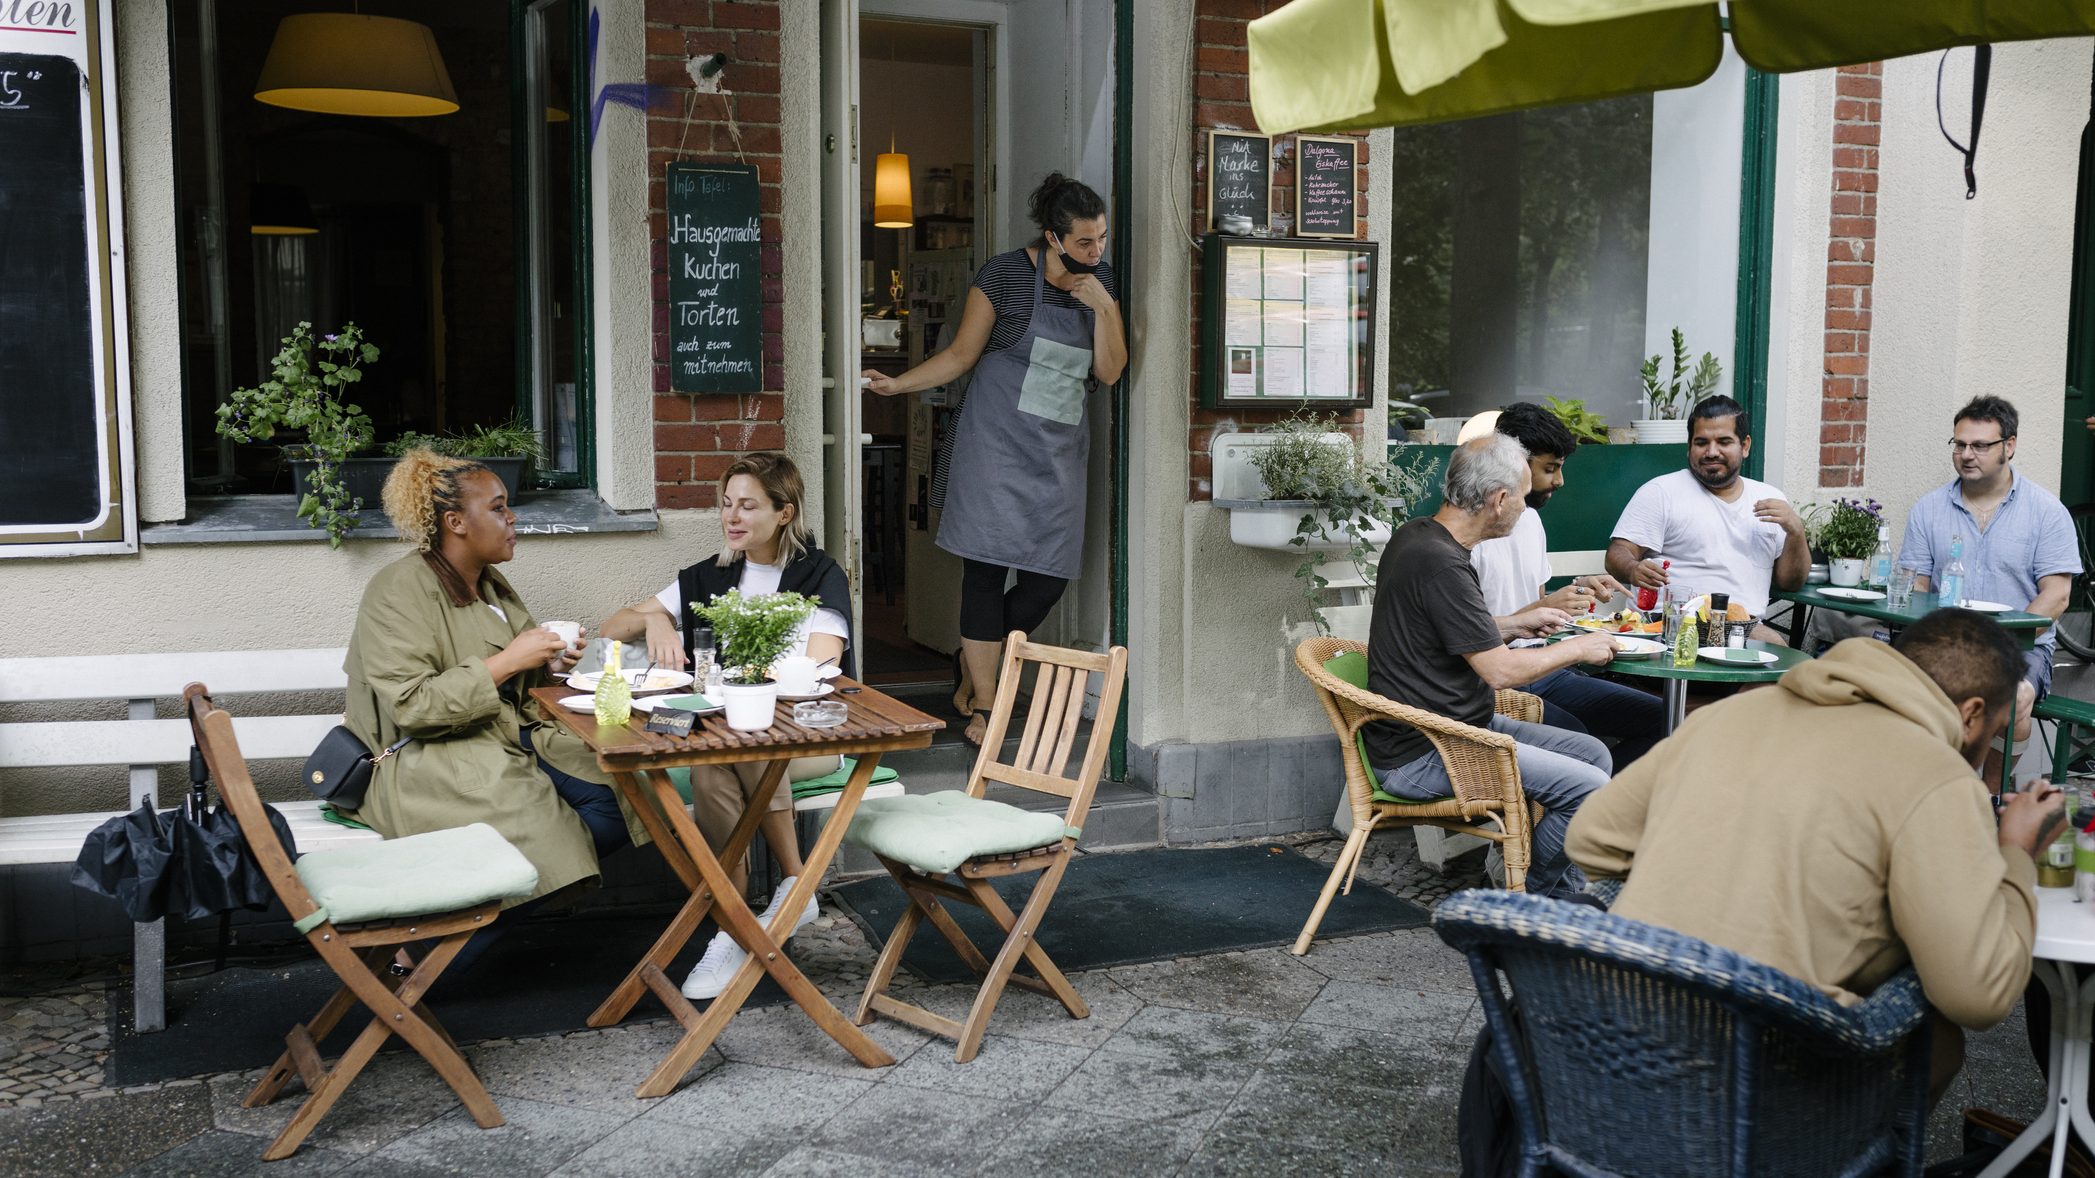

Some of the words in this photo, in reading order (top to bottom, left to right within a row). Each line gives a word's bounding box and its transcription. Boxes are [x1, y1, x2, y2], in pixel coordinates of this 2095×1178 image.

[1218, 151, 1260, 174] Maske
[674, 174, 695, 200] Info
[1229, 172, 1244, 181] ins
[670, 213, 761, 257] Hausgemachte
[684, 252, 740, 280] Kuchen
[697, 283, 719, 298] und
[677, 300, 740, 326] Torten
[677, 335, 700, 352] auch
[705, 340, 732, 350] zum
[683, 353, 753, 375] mitnehmen
[649, 713, 691, 728] Reserviert
